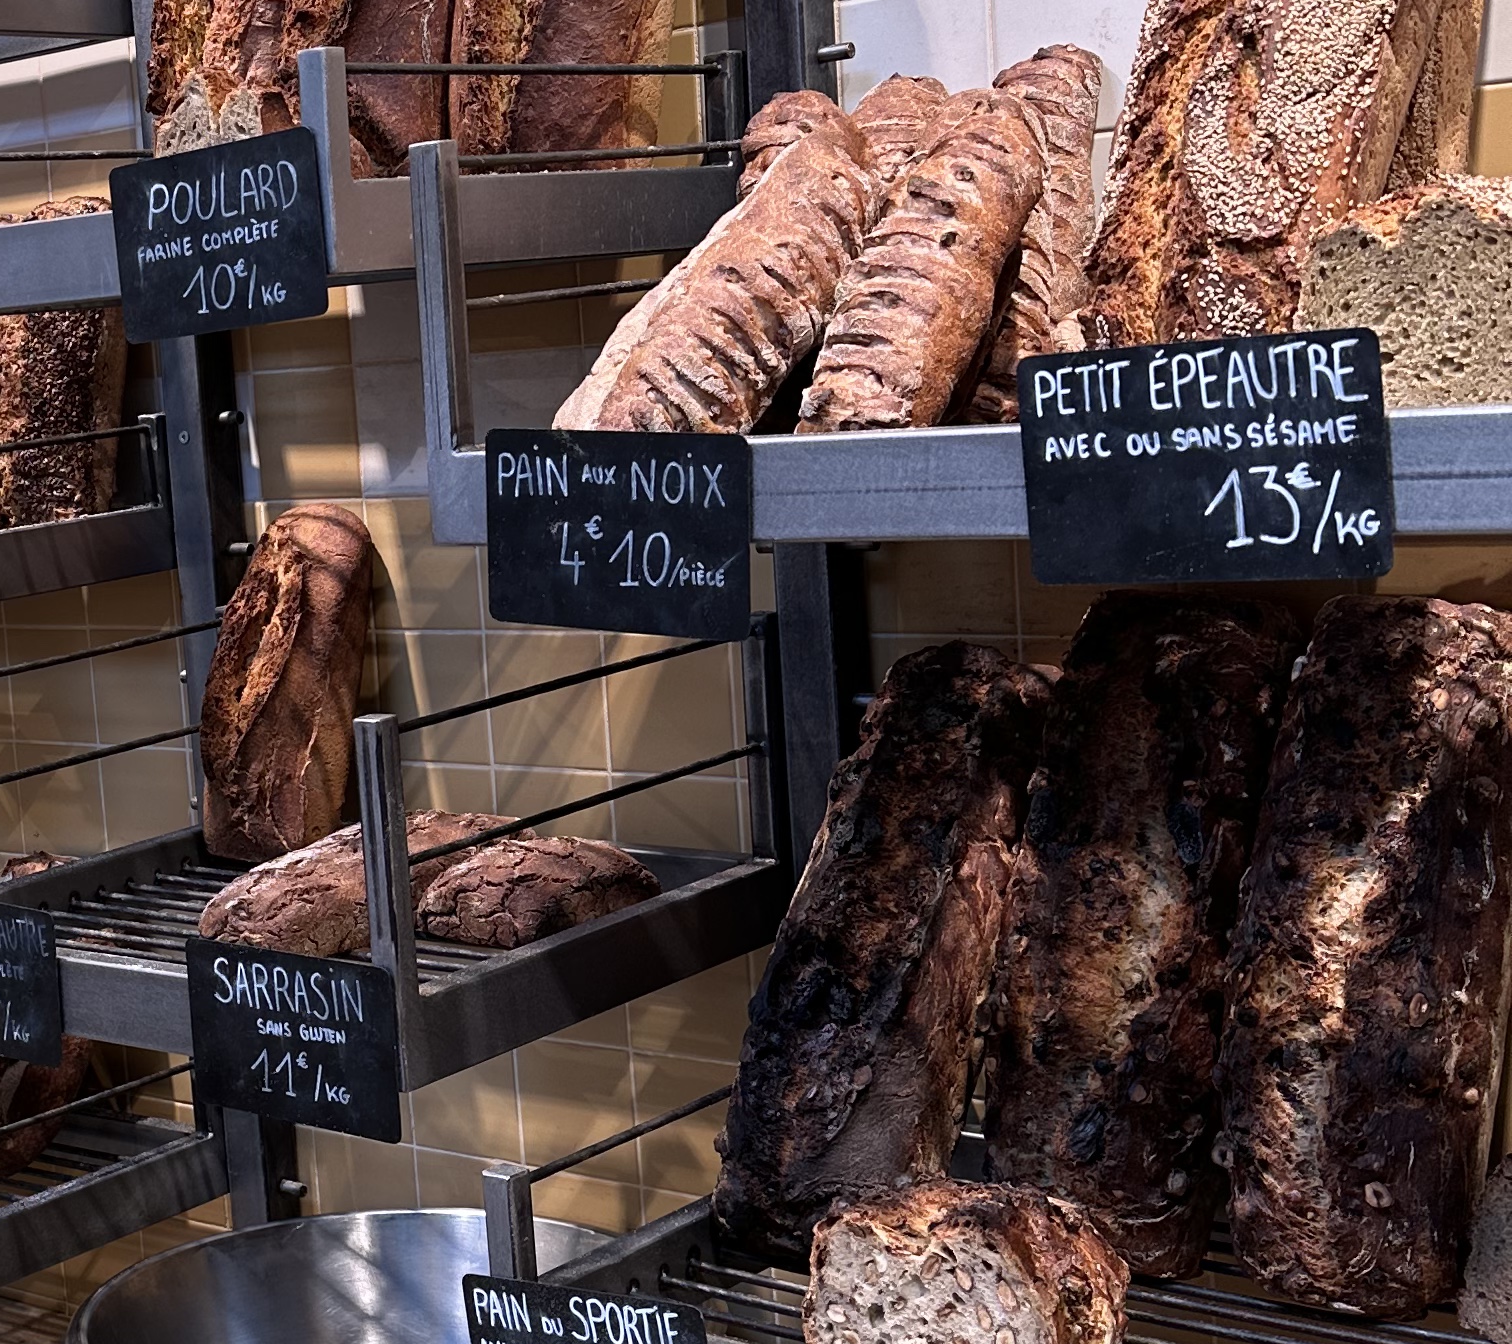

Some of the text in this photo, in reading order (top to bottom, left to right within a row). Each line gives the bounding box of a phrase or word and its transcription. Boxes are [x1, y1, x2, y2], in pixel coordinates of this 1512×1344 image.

[148, 160, 298, 230] POULARD
[138, 218, 279, 265] FARINE COMPLÈTE
[1148, 338, 1369, 410] ÉPEAUTRE
[1045, 413, 1358, 462] AVEC OU SANS SÉSAME
[581, 463, 617, 485] AUX
[256, 1018, 346, 1045] SANS GLUTEN
[541, 1316, 564, 1337] DU
